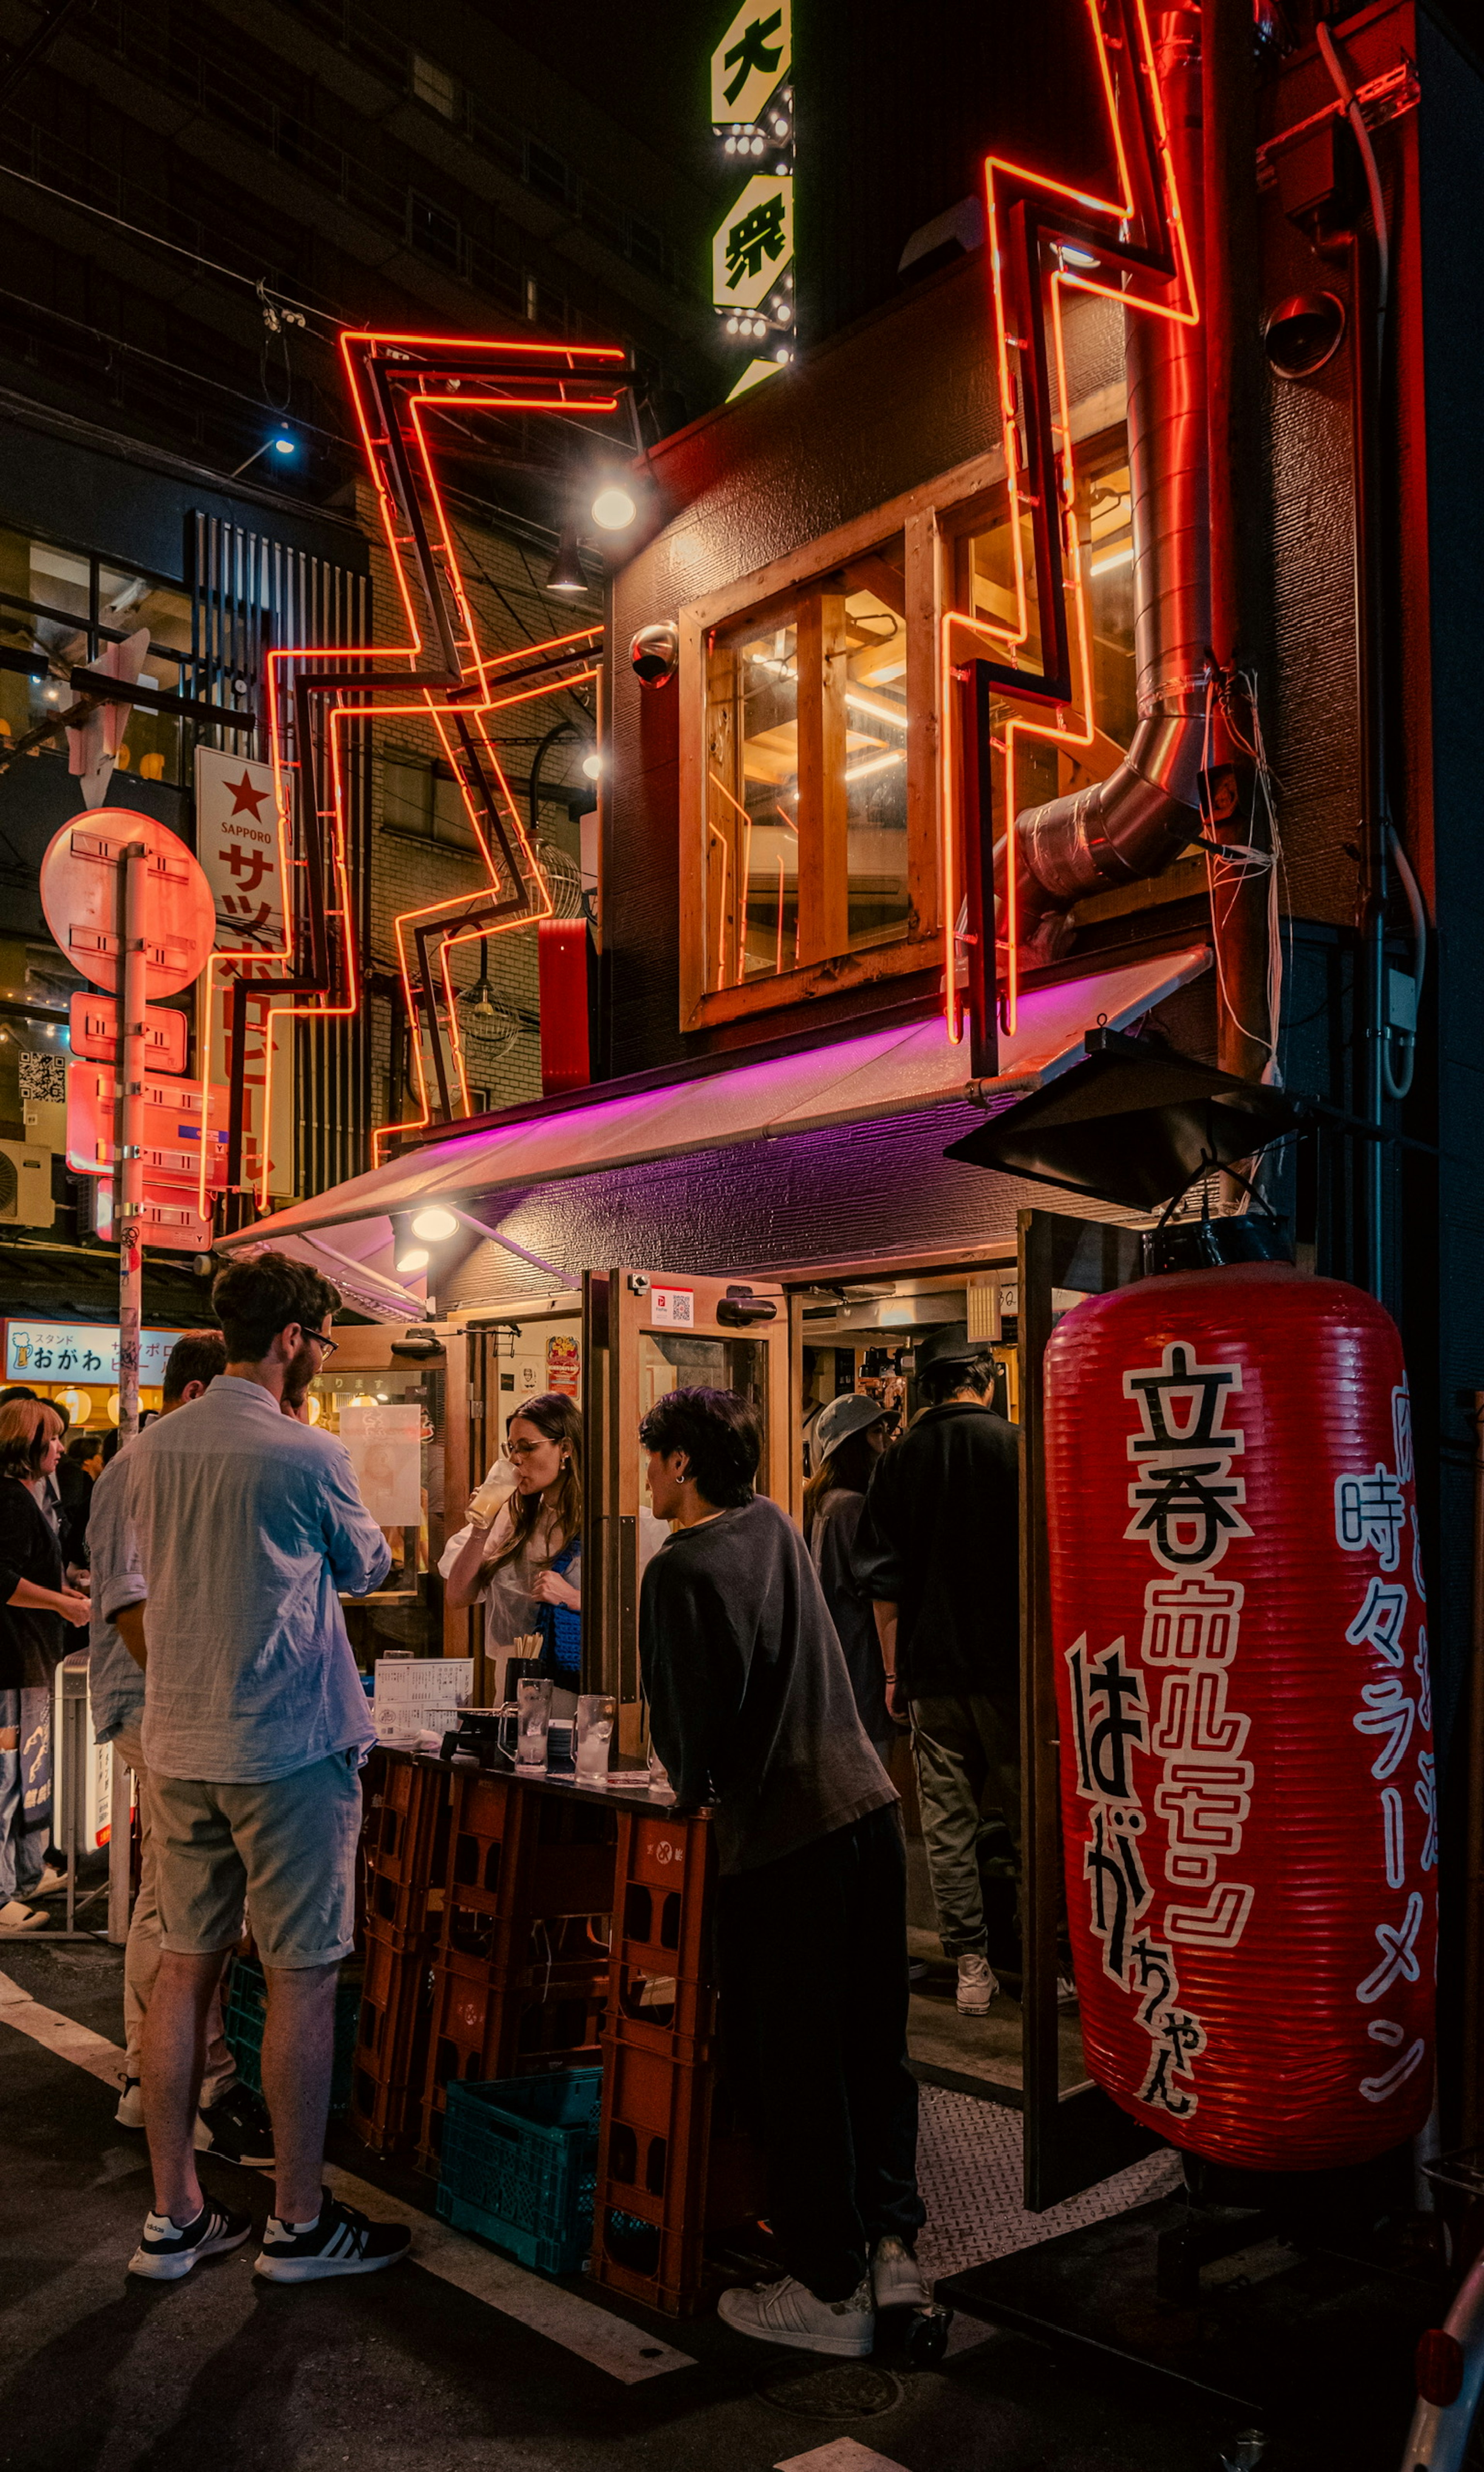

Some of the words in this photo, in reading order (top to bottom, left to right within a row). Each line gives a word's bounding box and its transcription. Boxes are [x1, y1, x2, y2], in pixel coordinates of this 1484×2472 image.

[221, 822, 271, 844] SAPPORO
[35, 1334, 73, 1345] スタンド
[34, 1347, 101, 1371] おがわ
[1334, 1462, 1427, 2103] 時々ラーメン
